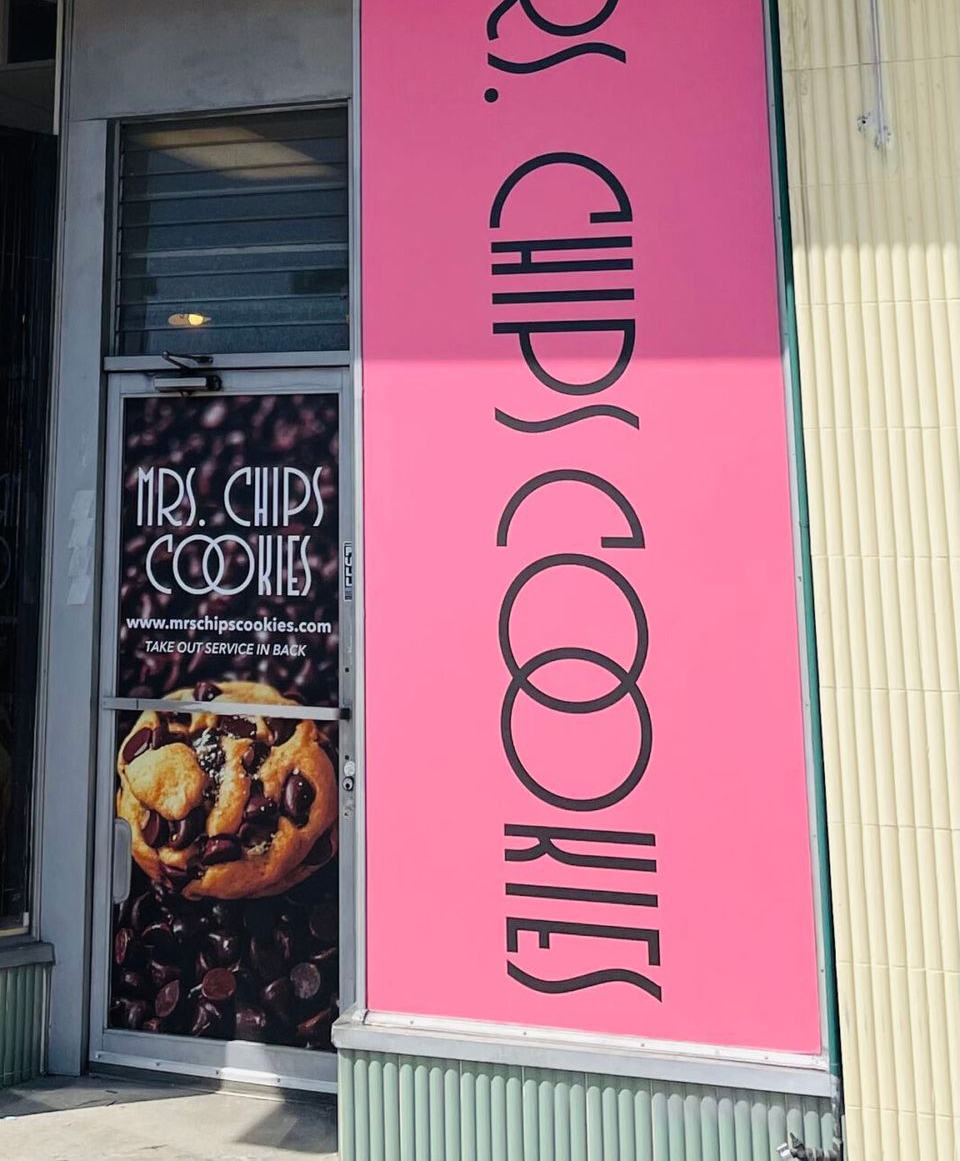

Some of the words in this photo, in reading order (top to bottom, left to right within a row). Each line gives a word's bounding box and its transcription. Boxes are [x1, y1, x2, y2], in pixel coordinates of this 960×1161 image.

[489, 151, 640, 433] CHIPS
[137, 466, 206, 527] MRS.
[223, 466, 325, 527] CHIPS
[145, 534, 313, 597] COOKIES
[126, 616, 332, 635] www.mrschipscookies.com
[145, 640, 175, 653] TAKE
[176, 641, 203, 654] OUT
[204, 642, 254, 655] SERVICE
[256, 643, 270, 656] IN
[272, 643, 308, 657] BACK
[496, 468, 663, 1003] COOKIES
